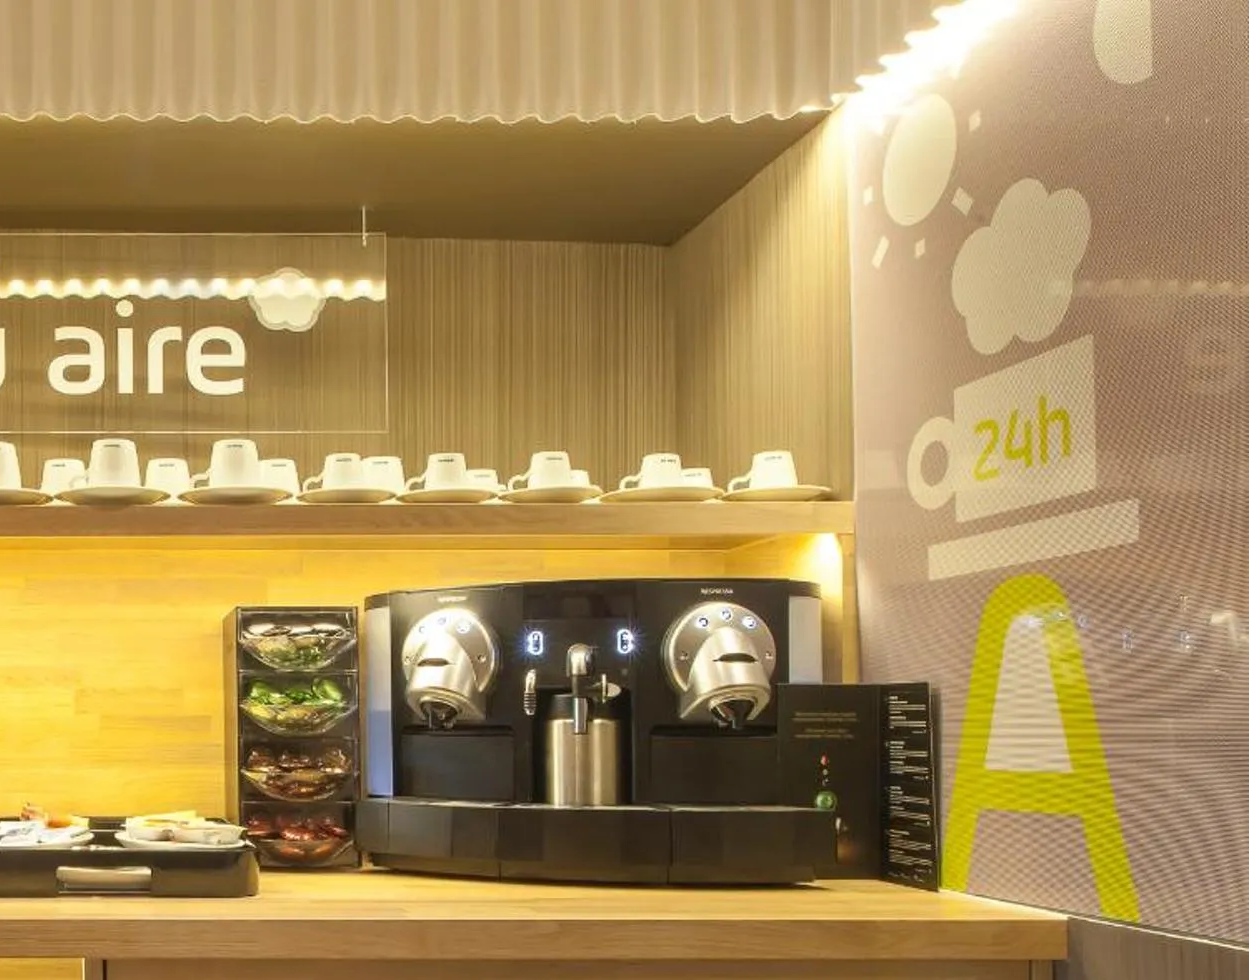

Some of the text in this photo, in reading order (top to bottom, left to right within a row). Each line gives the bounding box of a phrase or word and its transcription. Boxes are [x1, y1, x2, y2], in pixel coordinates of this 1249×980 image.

[47, 300, 247, 395] aire
[973, 394, 1071, 481] 24h
[941, 573, 1142, 923] A
